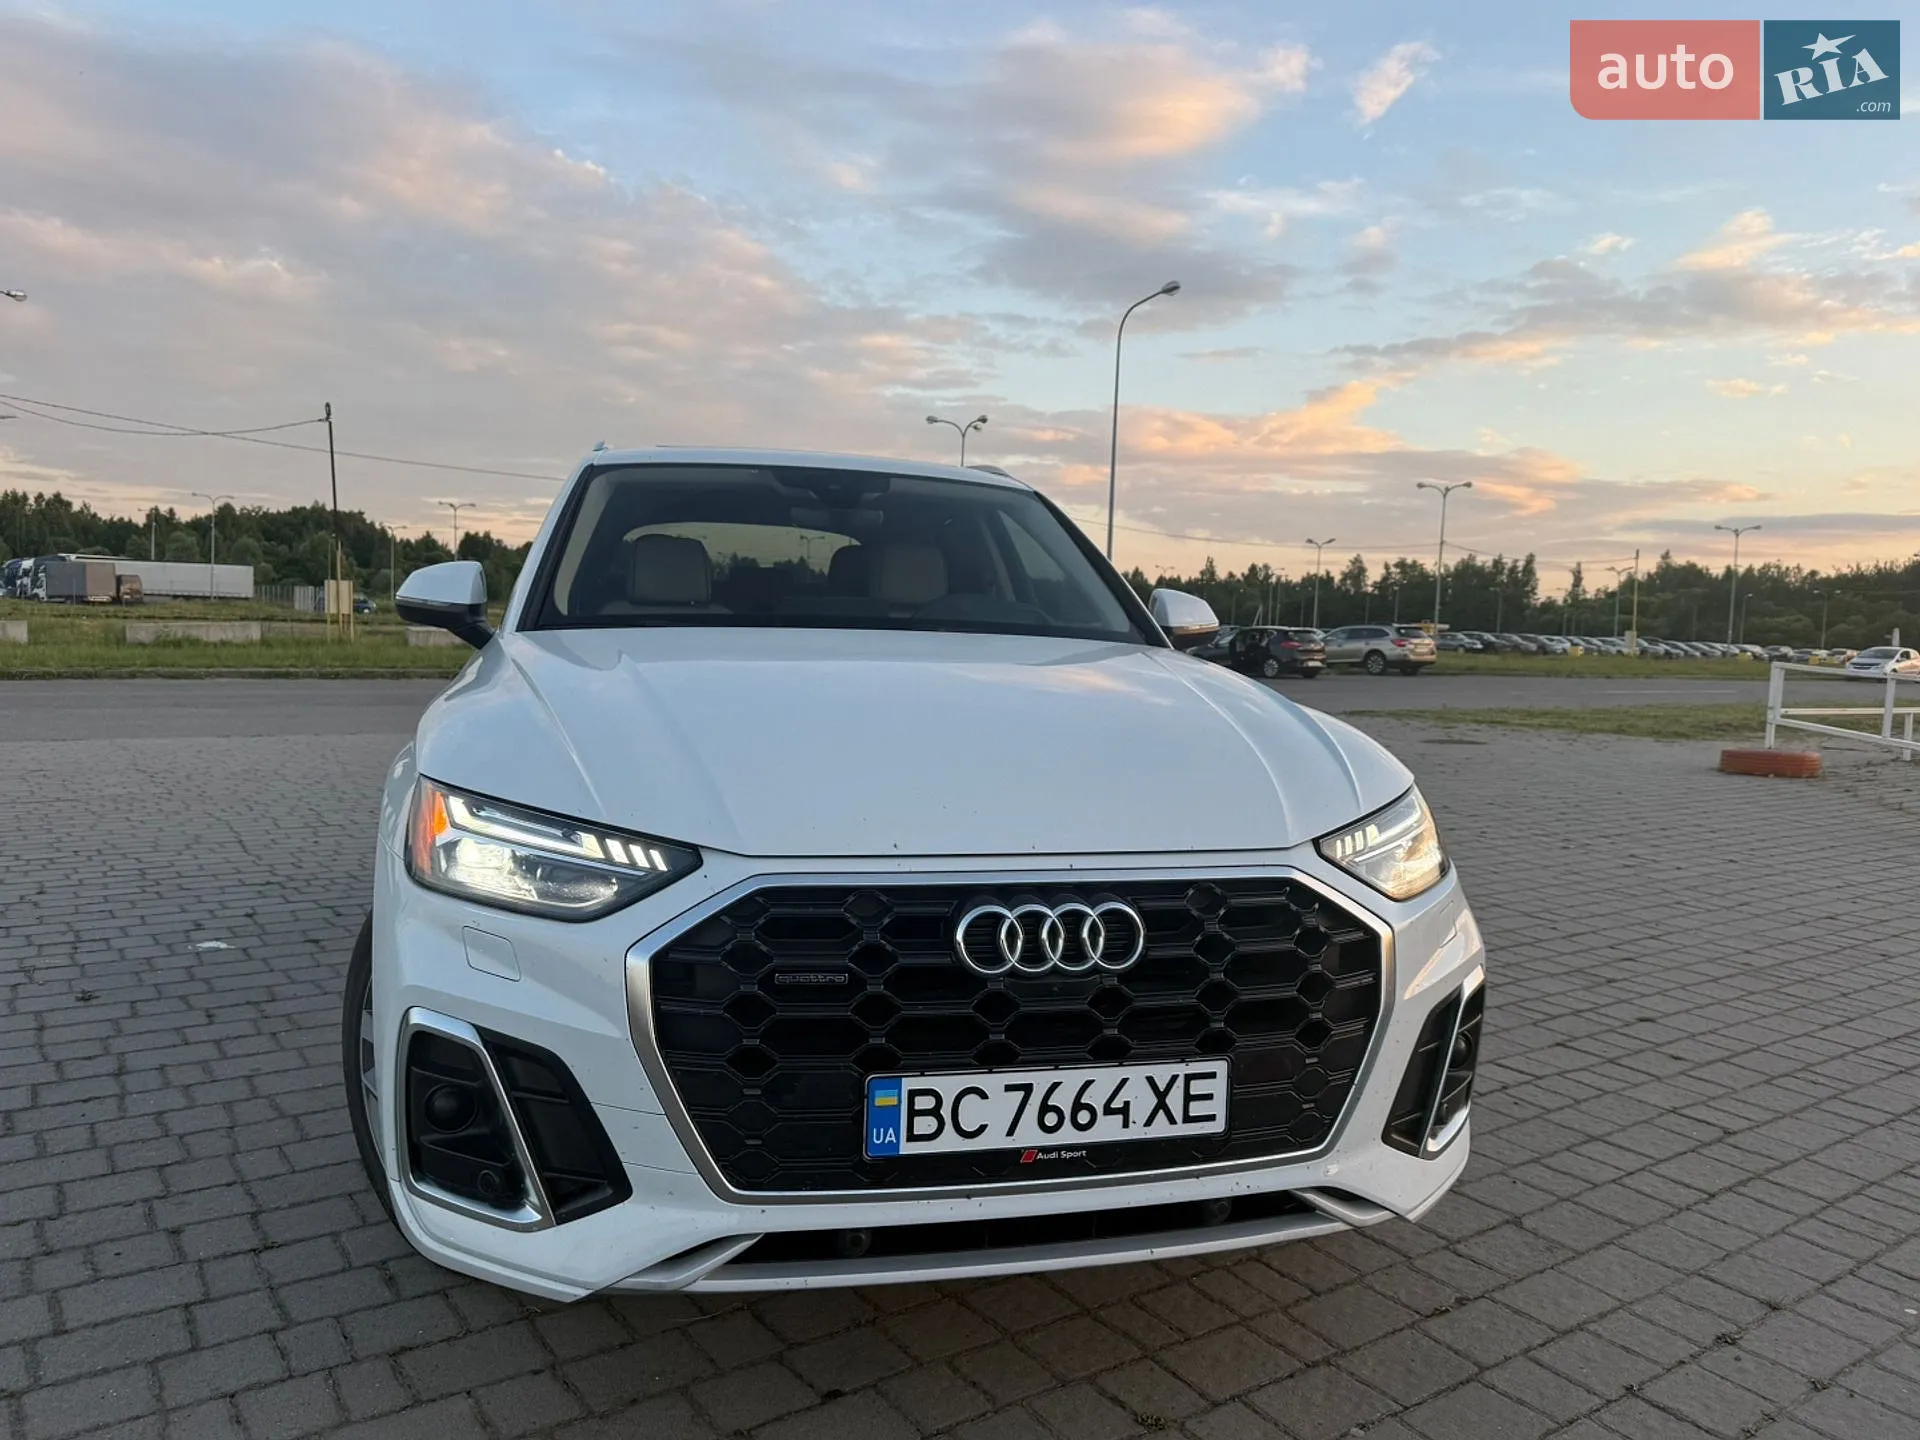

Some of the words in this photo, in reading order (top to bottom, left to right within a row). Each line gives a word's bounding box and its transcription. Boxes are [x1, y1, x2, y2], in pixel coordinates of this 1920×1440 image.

[905, 1085, 990, 1143] BC
[1003, 1076, 1131, 1138] 7664
[1143, 1071, 1218, 1128] XE
[873, 1127, 897, 1145] UA
[1036, 1150, 1059, 1160] Audi
[1060, 1150, 1087, 1159] Sport
